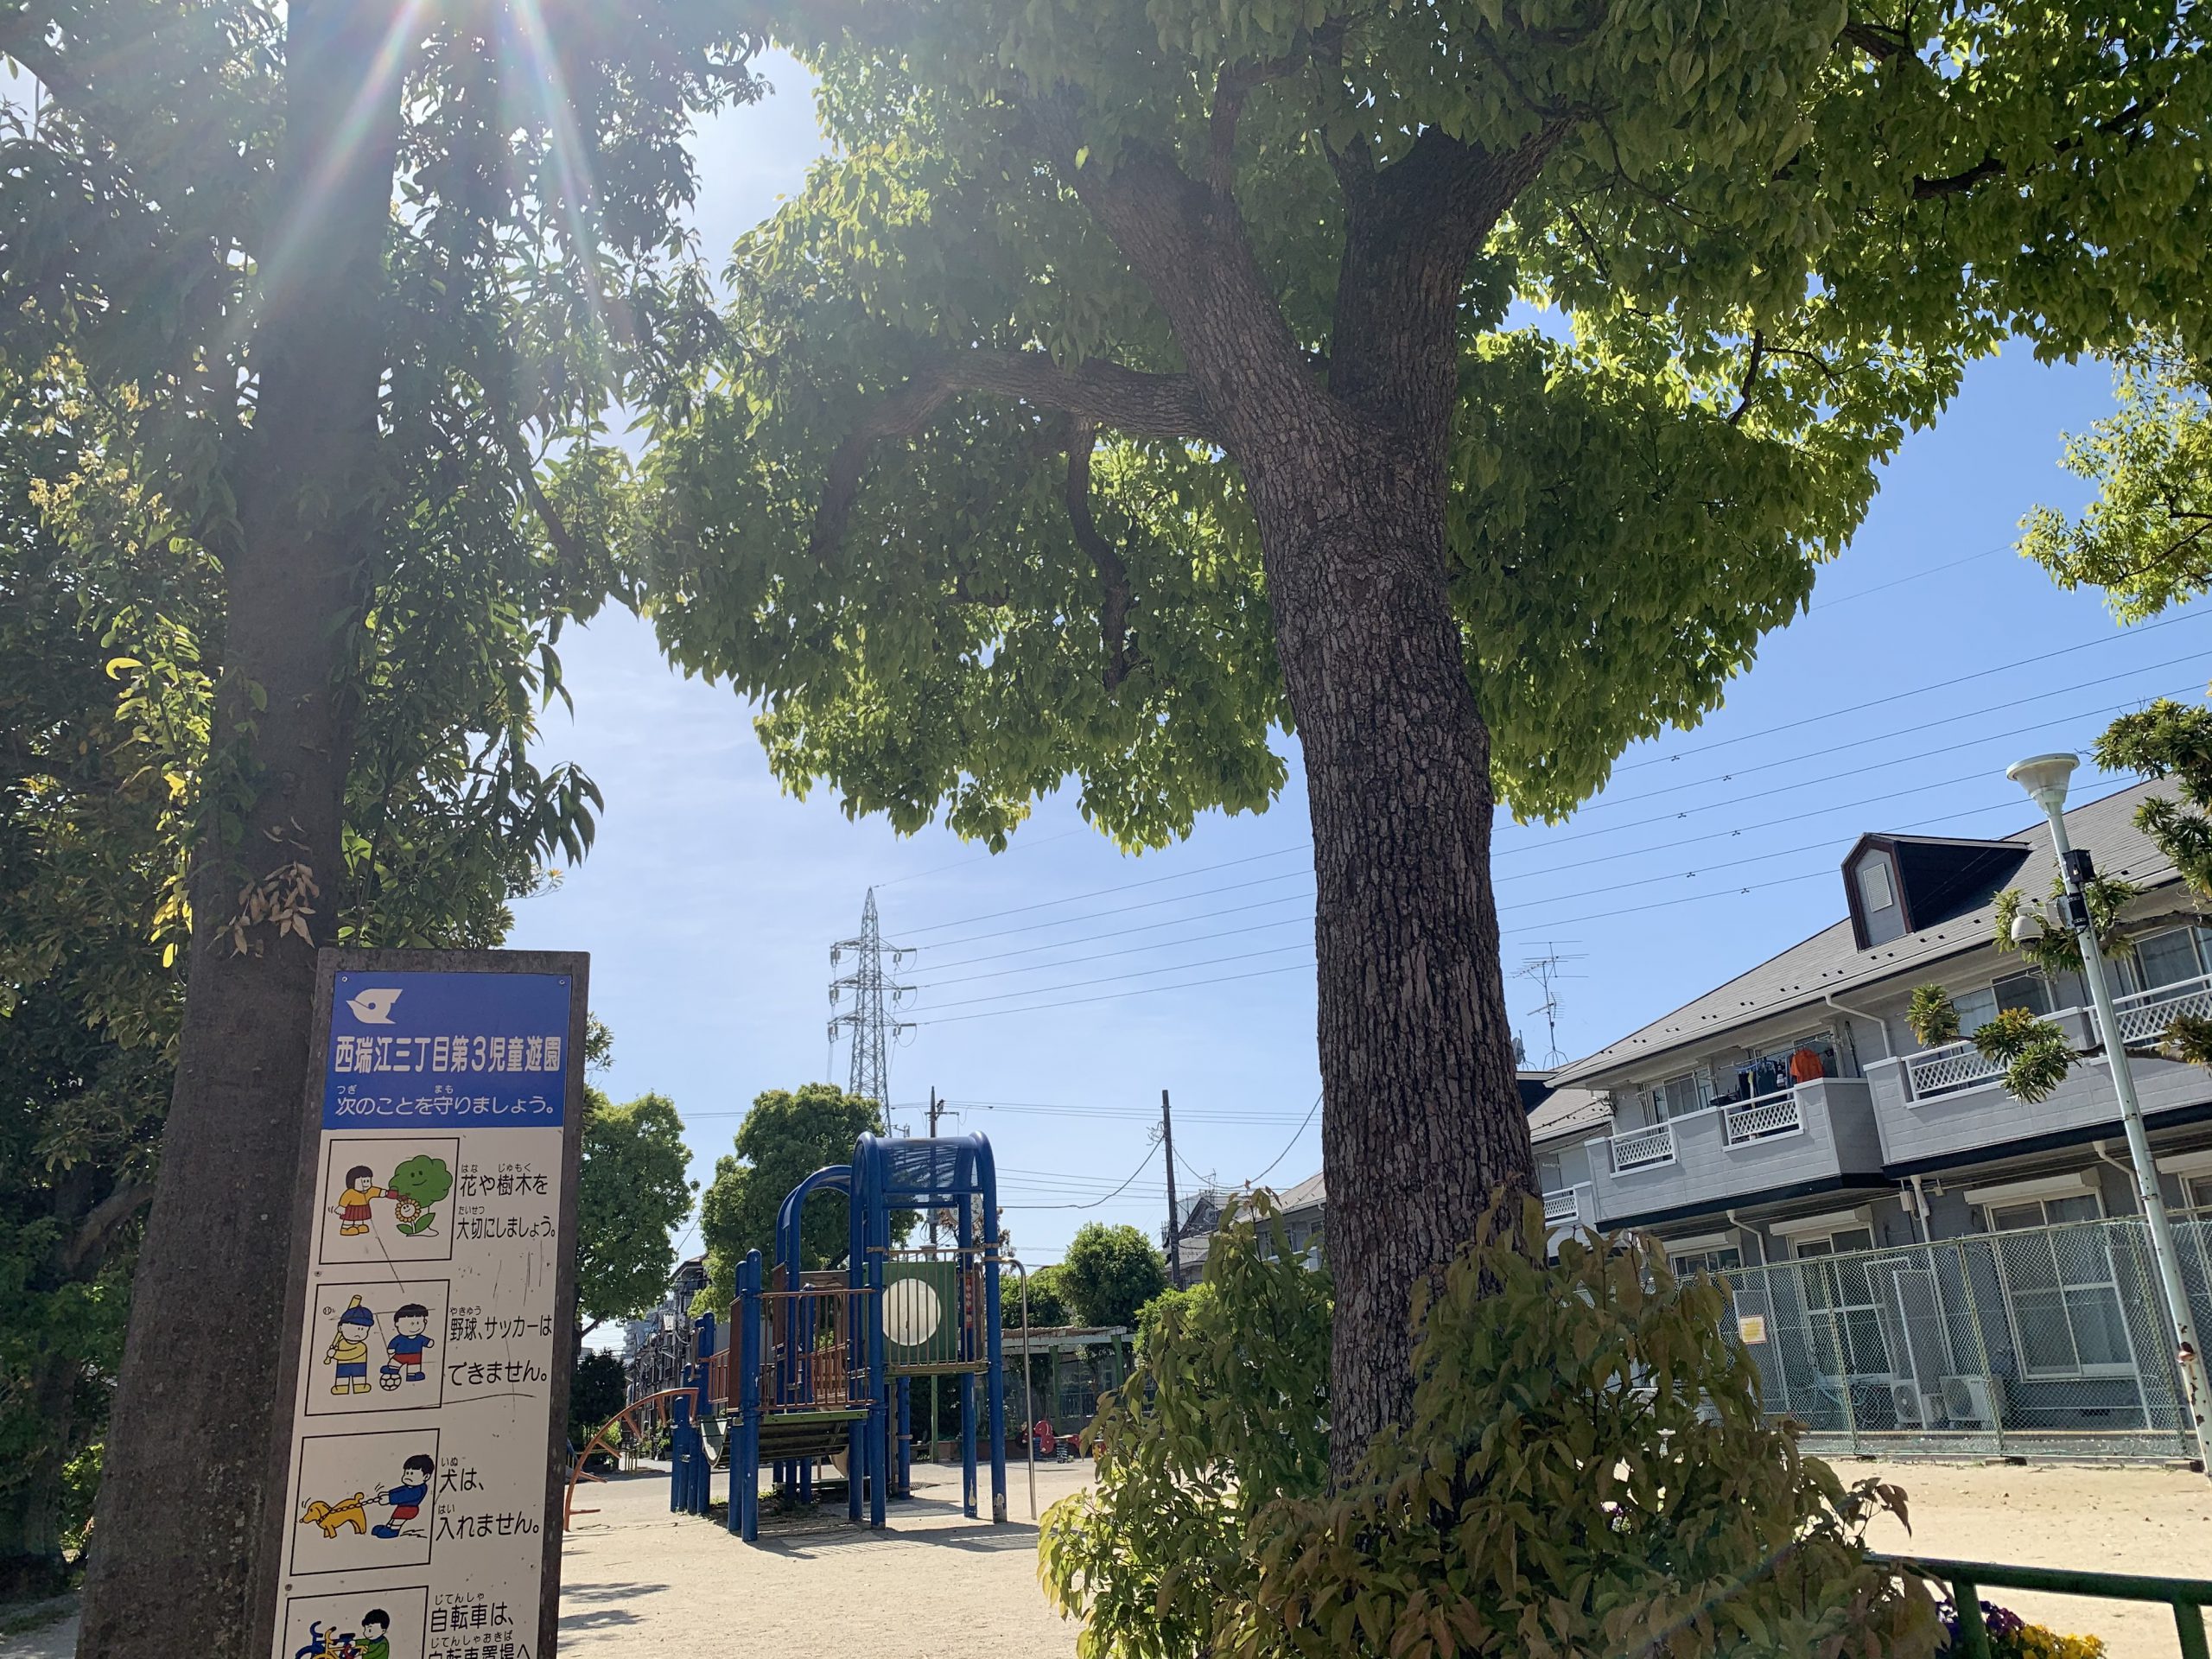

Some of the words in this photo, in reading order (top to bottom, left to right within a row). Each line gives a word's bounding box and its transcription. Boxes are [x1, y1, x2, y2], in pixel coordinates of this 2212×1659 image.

[334, 1035, 562, 1073] 西瑞江三丁目第3児童遊園
[337, 1084, 357, 1095] つぎ
[434, 1084, 454, 1094] まも
[334, 1096, 554, 1116] 次のことを守りましょう。
[461, 1164, 478, 1173] はな
[498, 1162, 531, 1173] じゅもく
[460, 1173, 548, 1197] 花や樹木を
[458, 1205, 485, 1215] たいせつ
[456, 1216, 556, 1240] 大切にしましょう。
[449, 1306, 481, 1316] やきゅう
[449, 1314, 552, 1341] 野球、サッカーは
[448, 1359, 547, 1386] できません。
[441, 1457, 458, 1467] いぬ
[439, 1467, 484, 1493] 犬は、
[438, 1504, 455, 1515] はい
[435, 1510, 539, 1541] 入れません。
[435, 1592, 484, 1605] じてんしゃ
[430, 1601, 514, 1632] 自転車は、
